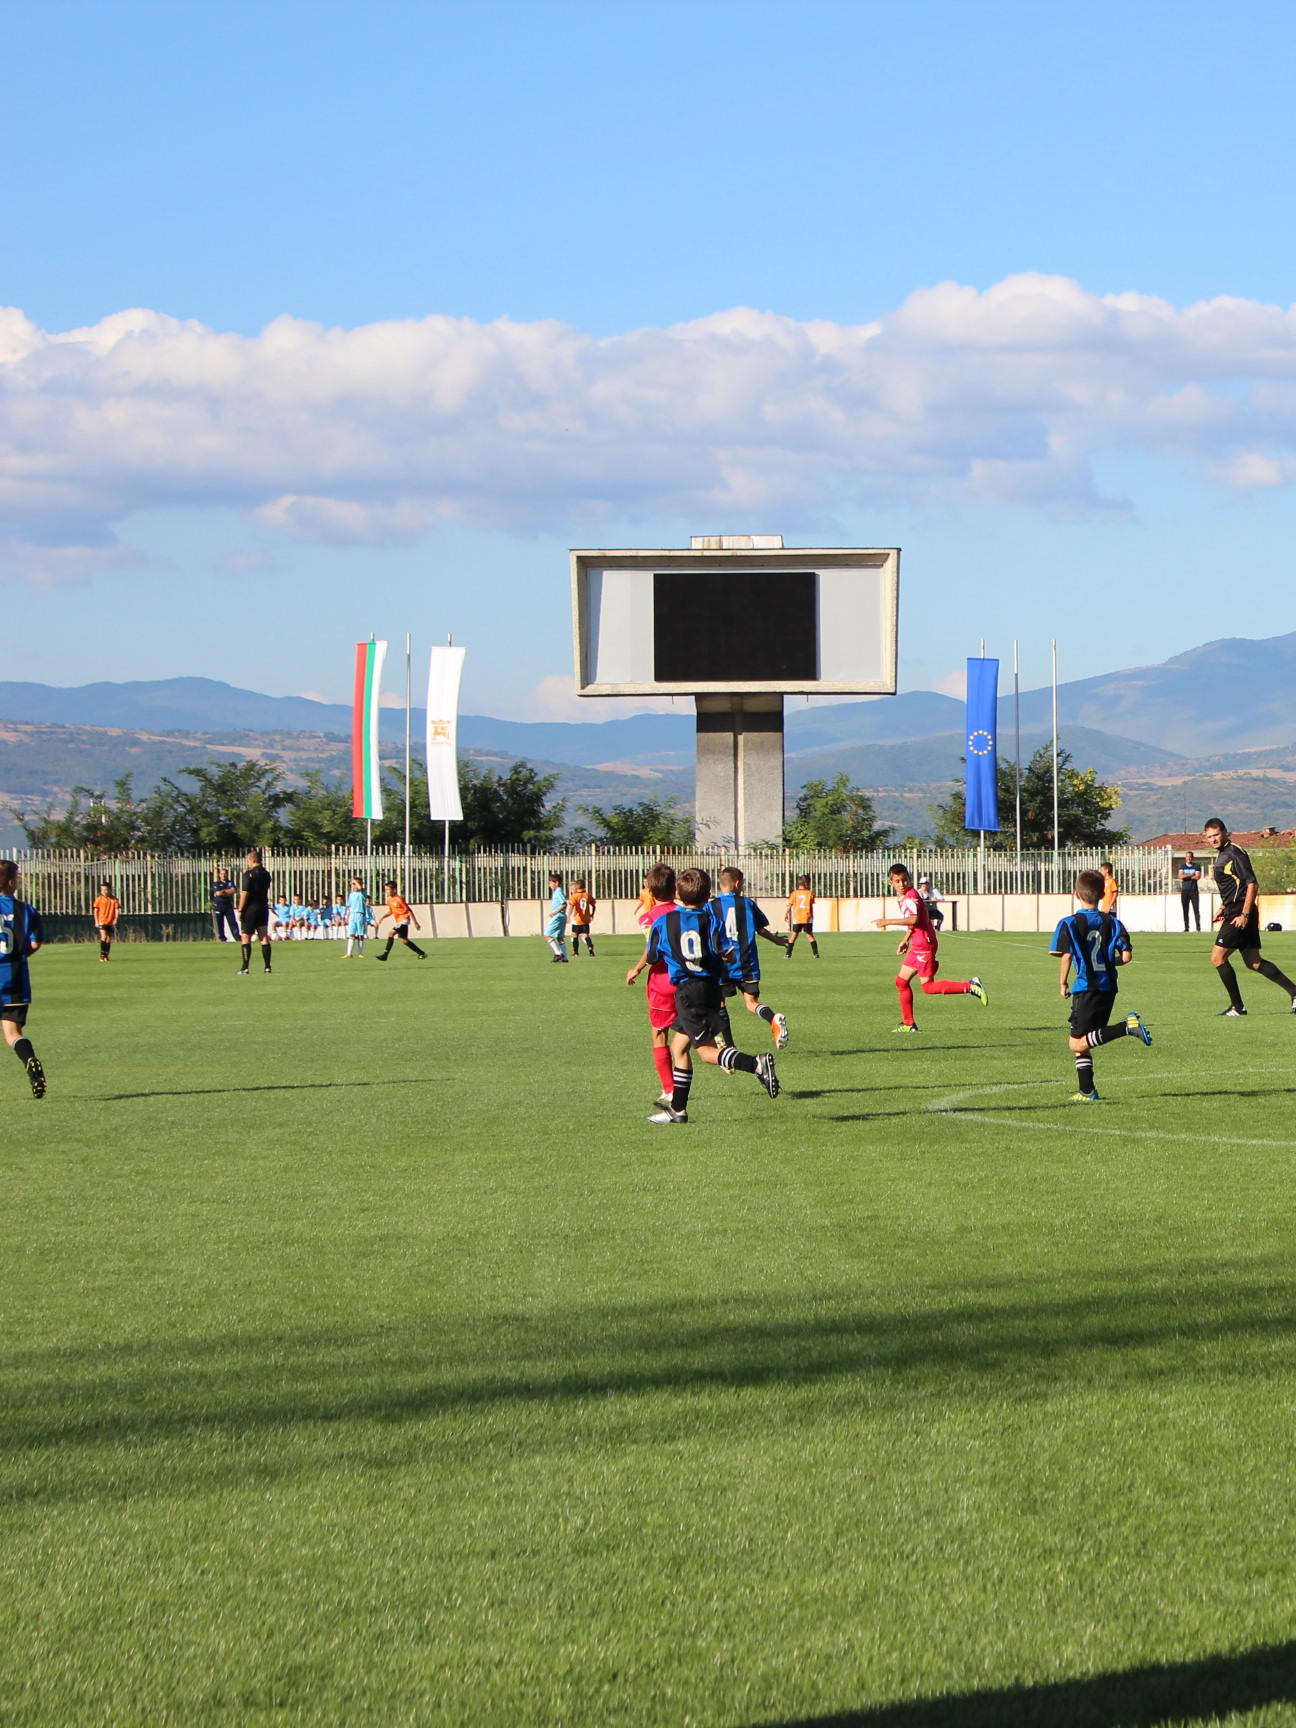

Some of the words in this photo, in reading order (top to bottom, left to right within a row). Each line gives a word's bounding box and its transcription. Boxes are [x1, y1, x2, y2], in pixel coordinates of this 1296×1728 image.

[799, 894, 806, 909] 2
[725, 907, 738, 941] 4
[680, 930, 703, 972] 9
[1087, 930, 1106, 971] 2
